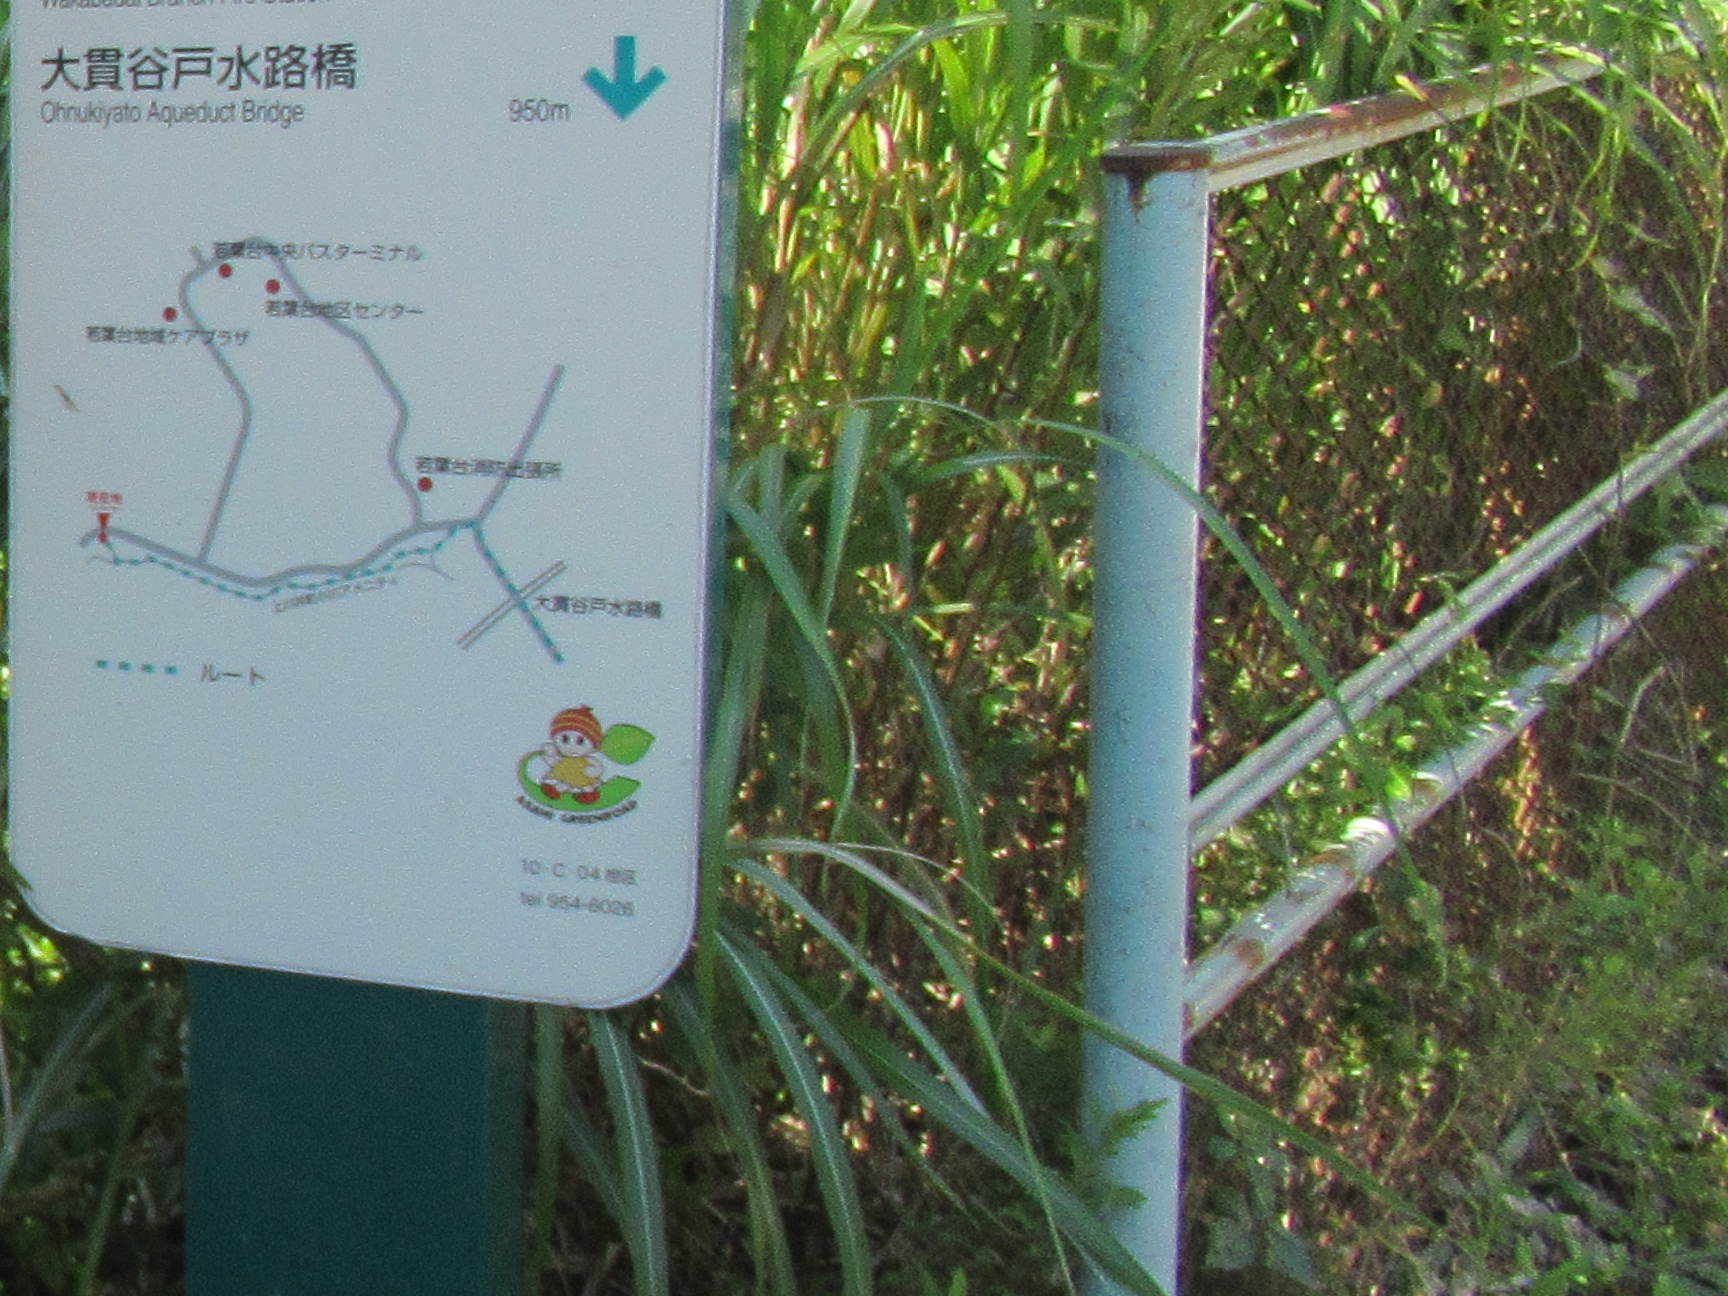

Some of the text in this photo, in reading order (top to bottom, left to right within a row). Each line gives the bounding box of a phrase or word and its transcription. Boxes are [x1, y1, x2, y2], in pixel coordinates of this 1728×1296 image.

[39, 43, 357, 94] 大貫谷戸水路橋
[40, 98, 304, 127] Ohnukiyato Aqueduct Bridge
[509, 97, 570, 124] 950m
[200, 663, 265, 685] ルート
